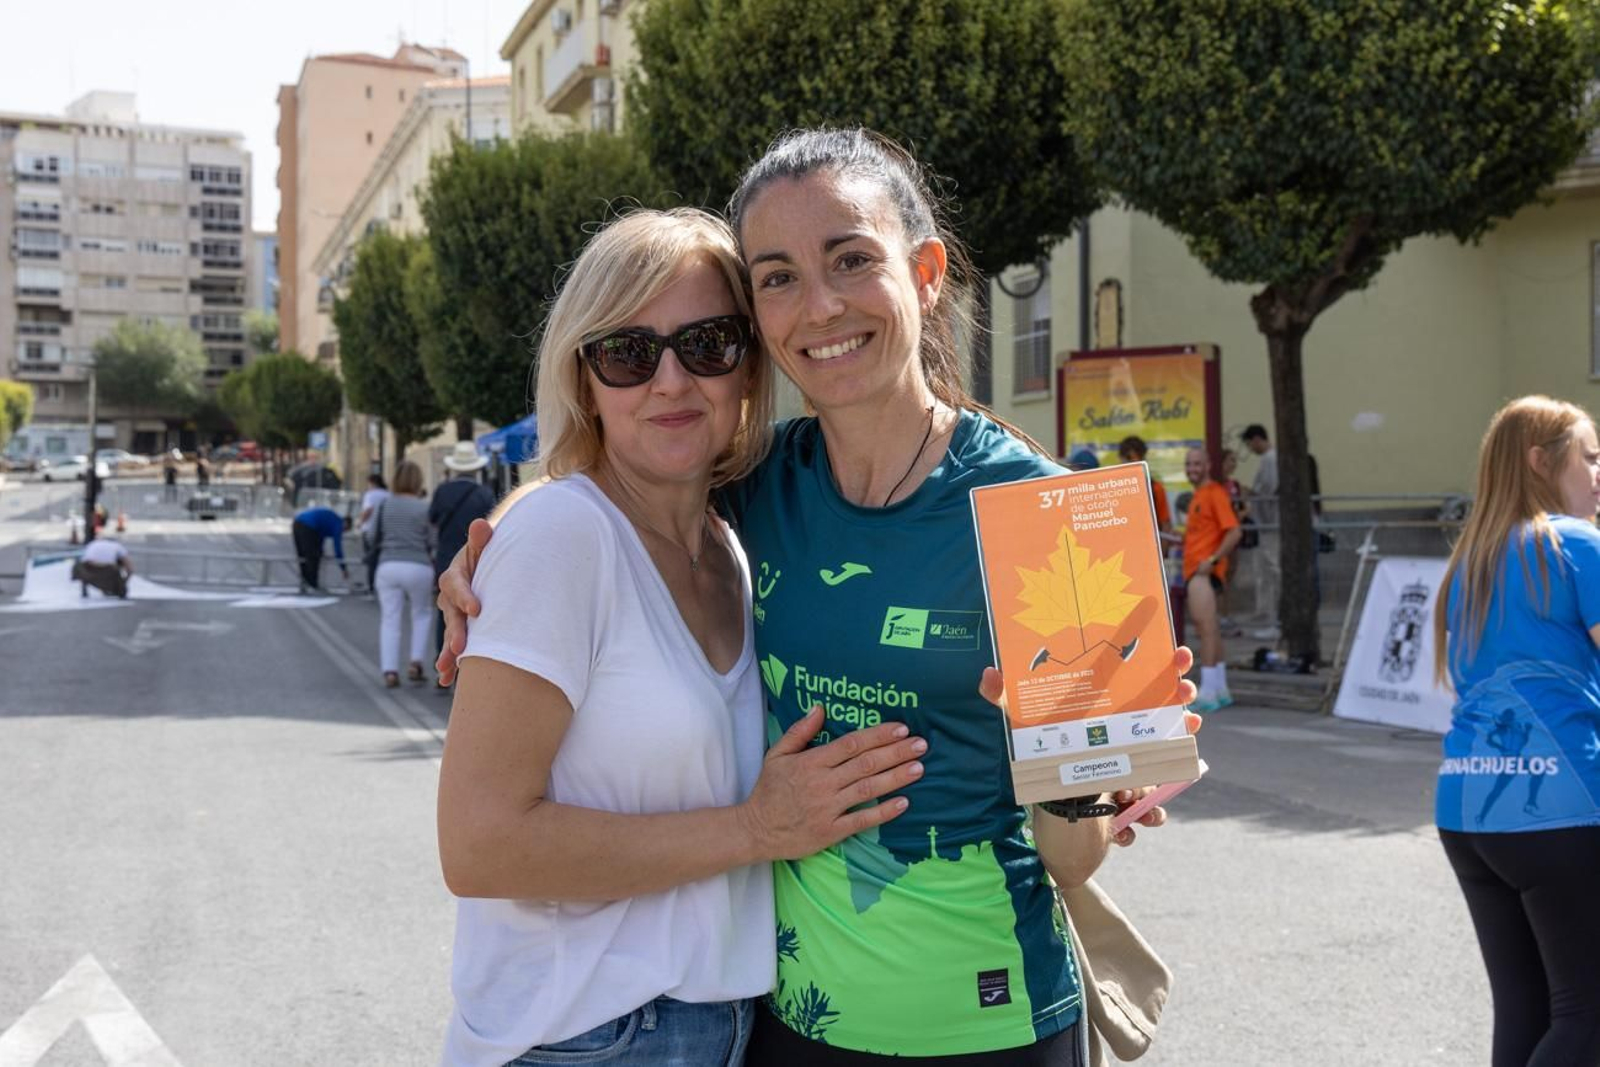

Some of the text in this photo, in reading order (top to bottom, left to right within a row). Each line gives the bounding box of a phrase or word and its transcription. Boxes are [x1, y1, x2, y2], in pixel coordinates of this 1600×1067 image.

[1068, 477, 1138, 494] milla urbana
[1038, 489, 1066, 508] 37
[1069, 485, 1140, 503] internacional
[1071, 503, 1084, 513] de
[1072, 508, 1114, 522] Manuel
[1073, 517, 1128, 531] Pancorbo
[943, 624, 967, 636] Jaén
[795, 665, 918, 708] Fundación
[1073, 760, 1118, 775] Campeona
[1092, 768, 1121, 778] Femenino
